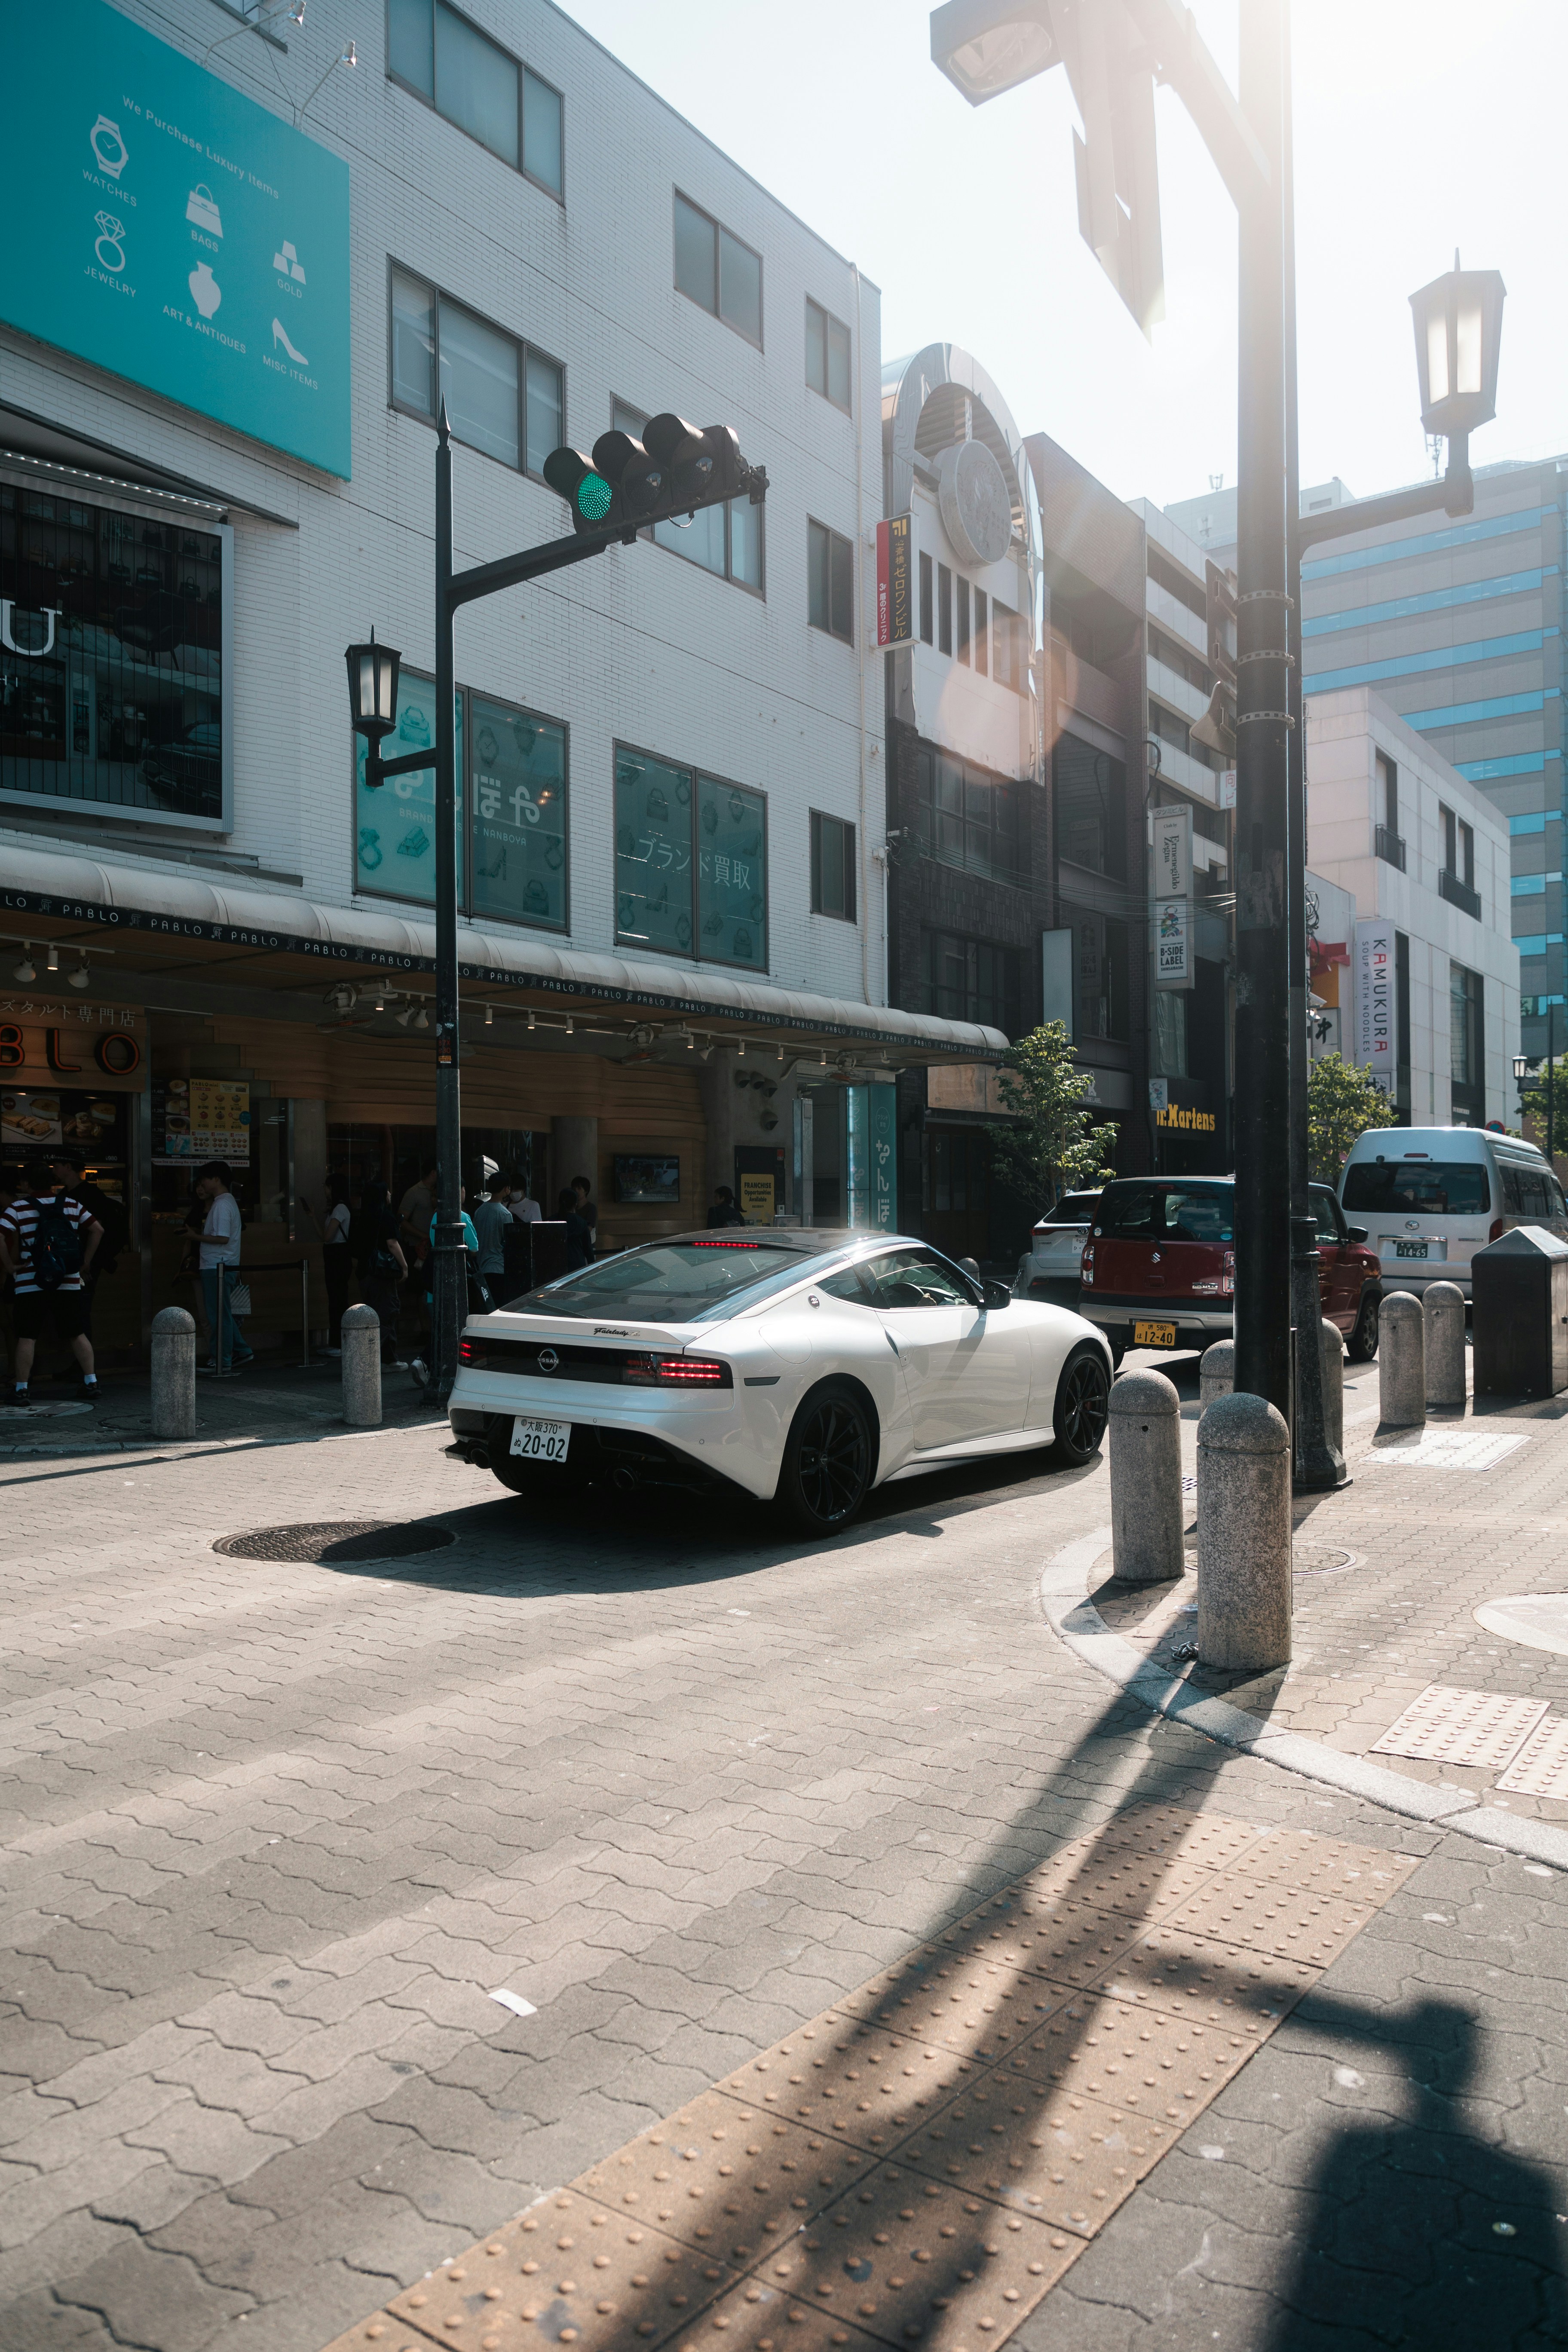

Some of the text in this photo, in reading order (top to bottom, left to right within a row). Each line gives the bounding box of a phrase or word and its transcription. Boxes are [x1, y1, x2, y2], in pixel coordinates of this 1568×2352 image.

[122, 95, 280, 200] We Purchase Luxury Items
[83, 168, 138, 208] WATCHES
[191, 229, 219, 254] BAGS
[83, 266, 137, 298] JEWELRY
[277, 278, 303, 299] GOLD
[163, 304, 247, 355] ART & ANTIQUES
[263, 355, 318, 391] MISC ITEMS
[879, 583, 887, 592] 3F
[399, 808, 433, 824] BRAND
[1155, 806, 1184, 816] タツミビル
[483, 827, 527, 846] NANBOYA
[639, 837, 751, 891] ブランド買取
[1160, 946, 1184, 956] B-SIDE
[1160, 955, 1184, 966] LABEL
[63, 904, 119, 922] PABLO
[151, 919, 202, 935] PABLO
[231, 931, 278, 946] PABLO
[304, 943, 347, 957] PABLO
[371, 953, 411, 967] PABLO
[490, 971, 524, 984] PABLO
[543, 980, 574, 992] PABLO
[592, 988, 621, 999] PABLO
[637, 995, 665, 1006] PABLO
[680, 1002, 706, 1013] PABLO
[720, 1008, 744, 1019] PABLO
[757, 1014, 780, 1024] PABLO
[792, 1020, 814, 1029] PABLO
[825, 1026, 846, 1034] PABLO
[857, 1030, 876, 1039] PABLO
[886, 1035, 905, 1043] PABLO
[914, 1039, 932, 1047] PABLO
[1373, 939, 1387, 1052] KAMUKURA
[0, 999, 136, 1028] ズタルト専門店
[876, 1139, 890, 1232] なんぼ
[1404, 1249, 1426, 1257] 14-65
[593, 1327, 629, 1337] Fairlady
[1144, 1331, 1173, 1344] 12-40
[514, 1433, 566, 1459] ぬ 20-02
